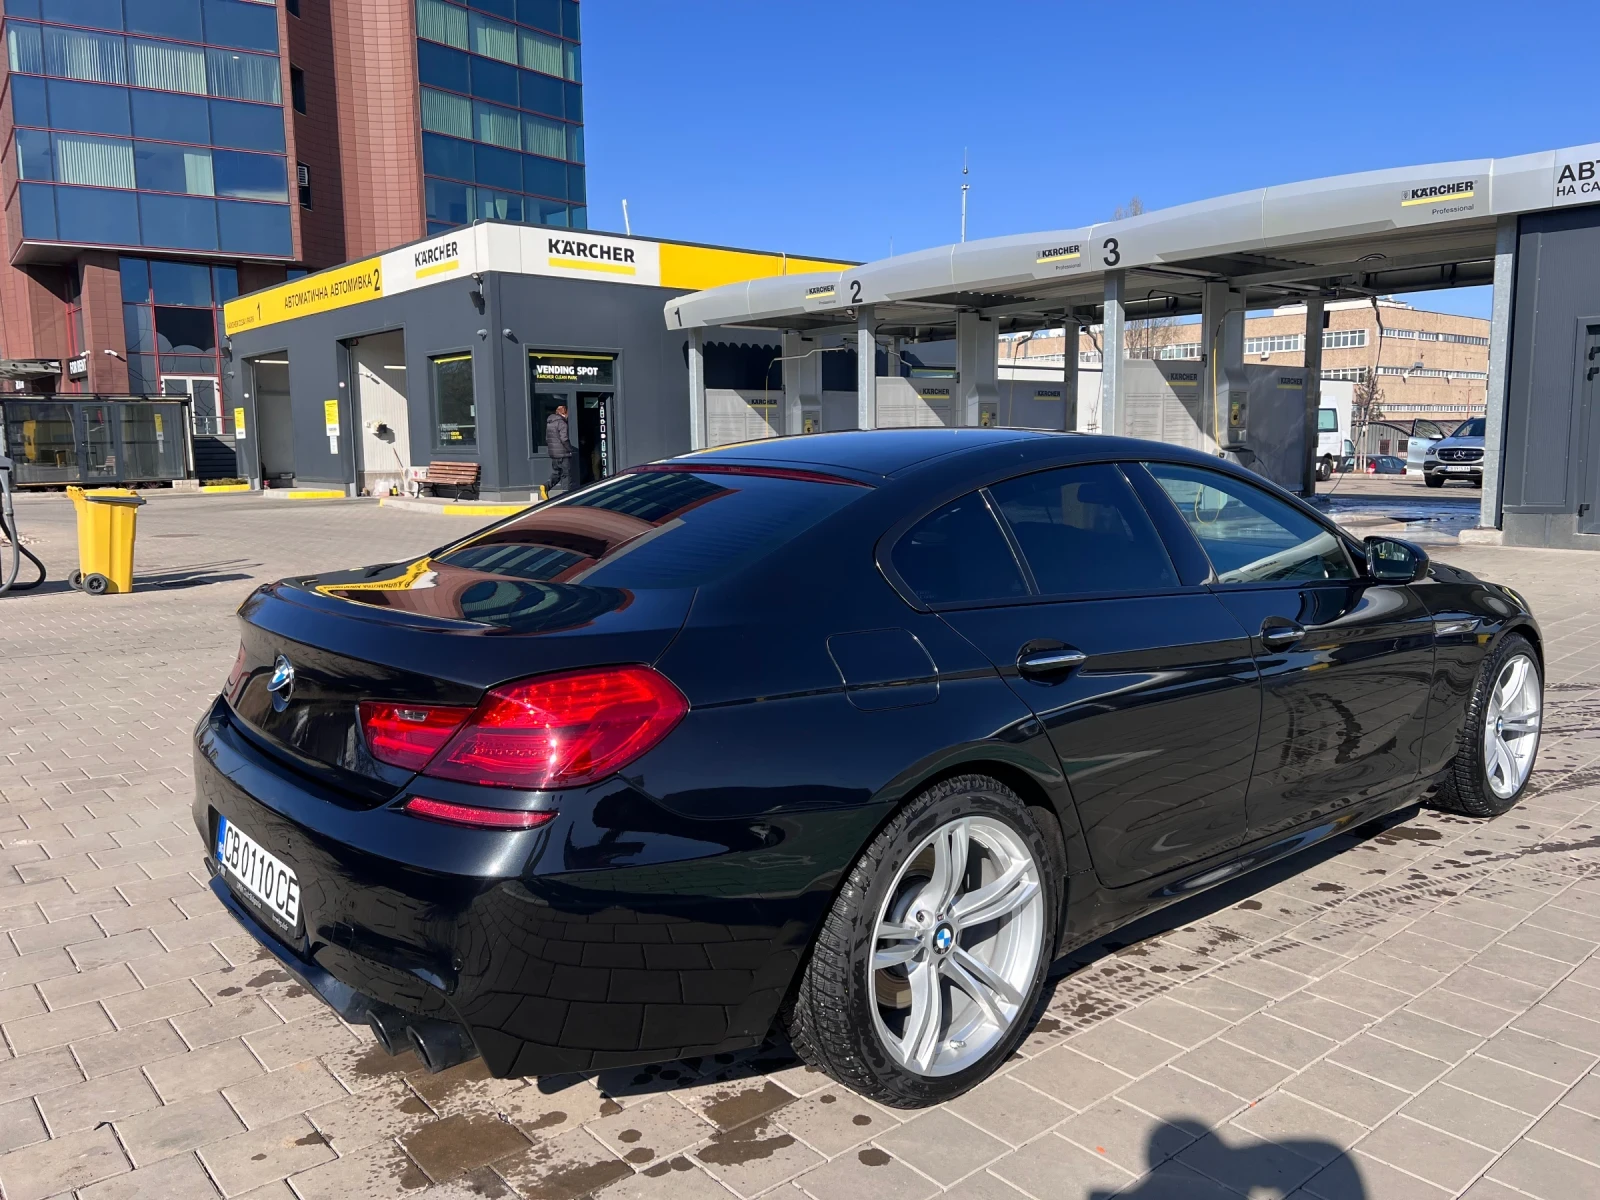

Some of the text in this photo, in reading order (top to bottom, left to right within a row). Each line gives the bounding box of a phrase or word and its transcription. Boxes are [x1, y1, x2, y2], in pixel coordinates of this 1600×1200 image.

[1411, 180, 1474, 199] KÄRCHER
[1556, 184, 1577, 197] НА
[1432, 203, 1475, 215] Professional
[414, 241, 459, 267] KÄRCHER
[548, 237, 636, 263] KÄRCHER
[1042, 244, 1080, 258] KÄRCHER
[1103, 238, 1120, 267] 3
[1055, 263, 1081, 271] Professional
[373, 268, 380, 292] 2
[284, 274, 372, 309] АВТОМАТИЧНА АВТОМИВКА
[850, 280, 863, 304] 2
[256, 302, 262, 321] 1
[674, 307, 683, 327] 1
[536, 364, 599, 376] VENDING SPOT
